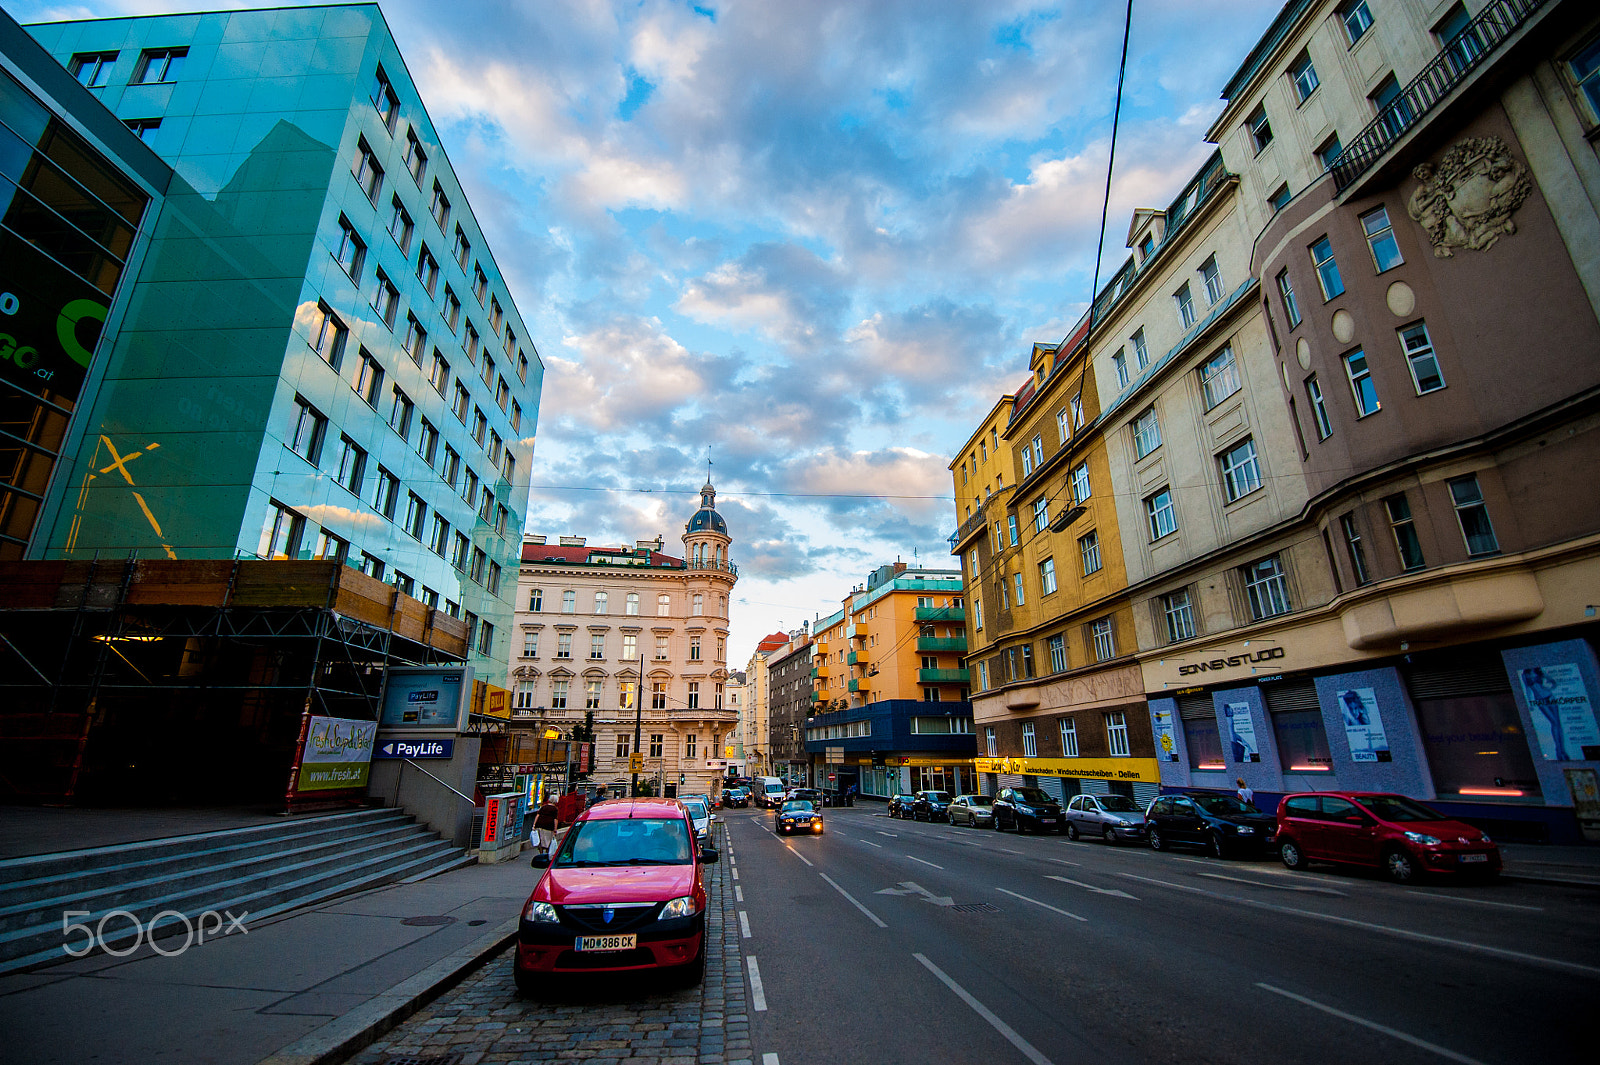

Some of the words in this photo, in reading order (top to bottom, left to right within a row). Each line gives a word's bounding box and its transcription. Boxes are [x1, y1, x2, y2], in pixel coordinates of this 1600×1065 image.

[1179, 646, 1285, 676] SONNENSTUDIO
[410, 692, 436, 702] PayLife
[396, 742, 443, 758] PayLife
[309, 768, 361, 783] www.fresh.at
[1057, 768, 1113, 778] Windschutzscheiben
[488, 800, 498, 841] EUROPE
[583, 938, 595, 949] MD
[602, 937, 620, 949] 386
[621, 936, 634, 947] CK
